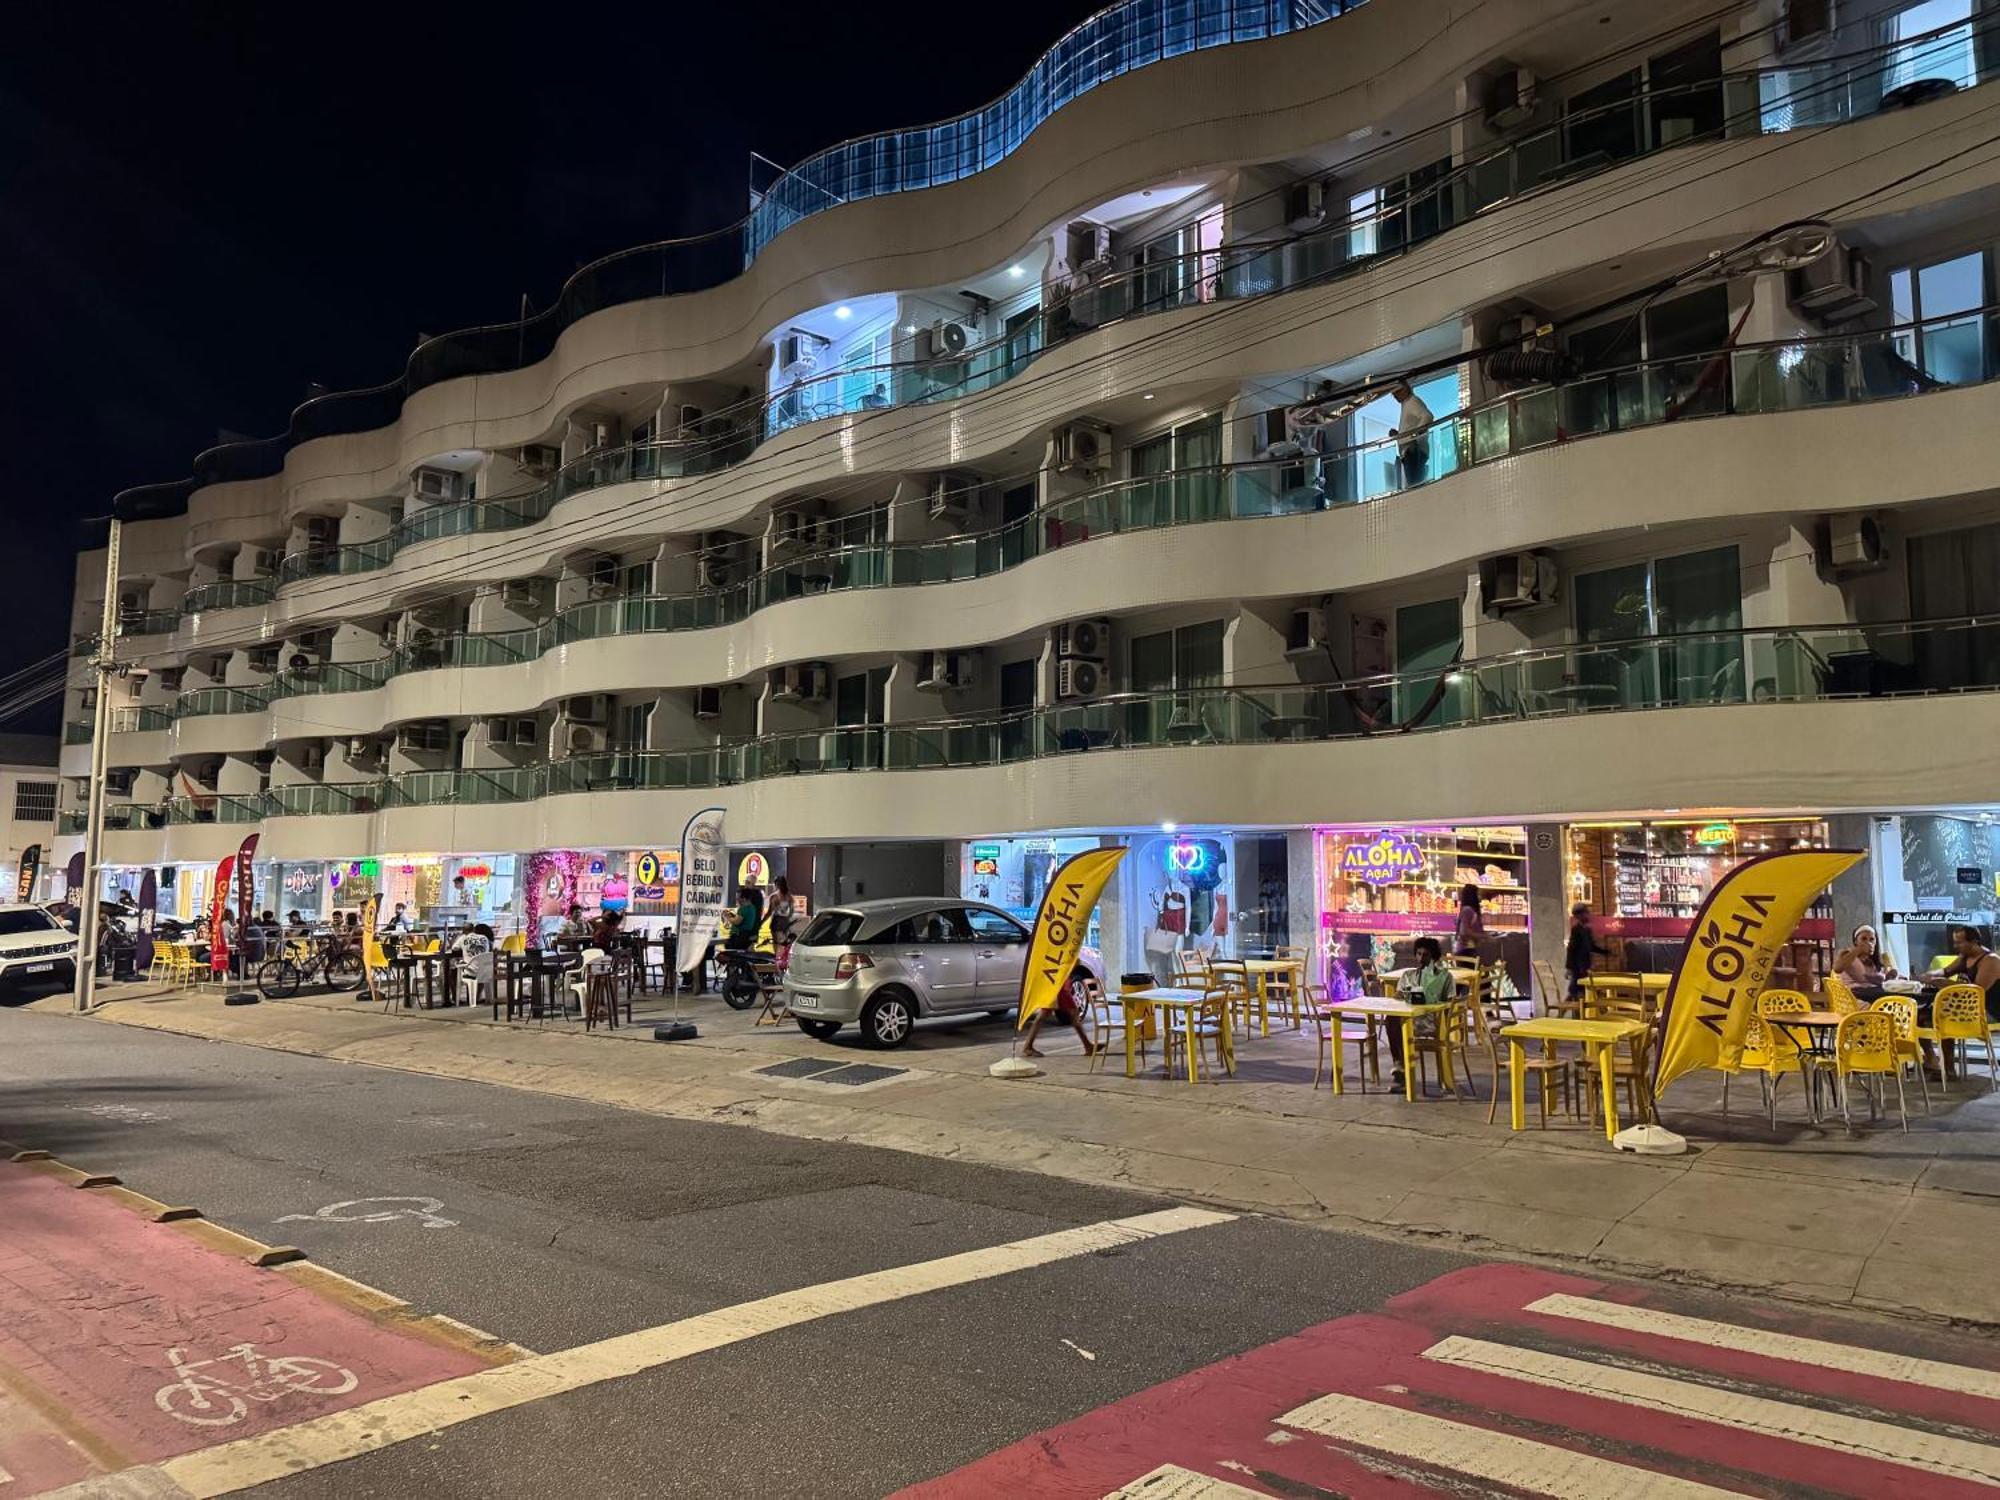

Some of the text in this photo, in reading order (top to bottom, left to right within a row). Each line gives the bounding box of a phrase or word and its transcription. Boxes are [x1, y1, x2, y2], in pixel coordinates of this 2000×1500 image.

[1694, 830, 1735, 842] ABERTO
[1345, 846, 1416, 866] ALOHA
[694, 858, 716, 872] GELO
[686, 873, 724, 888] BEBIDAS
[1366, 866, 1394, 880] AÇAÍ
[1904, 913, 1930, 922] Pastel
[1042, 883, 1085, 985] ALOHA
[1696, 895, 1777, 1037] ALOHA
[1746, 945, 1772, 999] AÇAÍ
